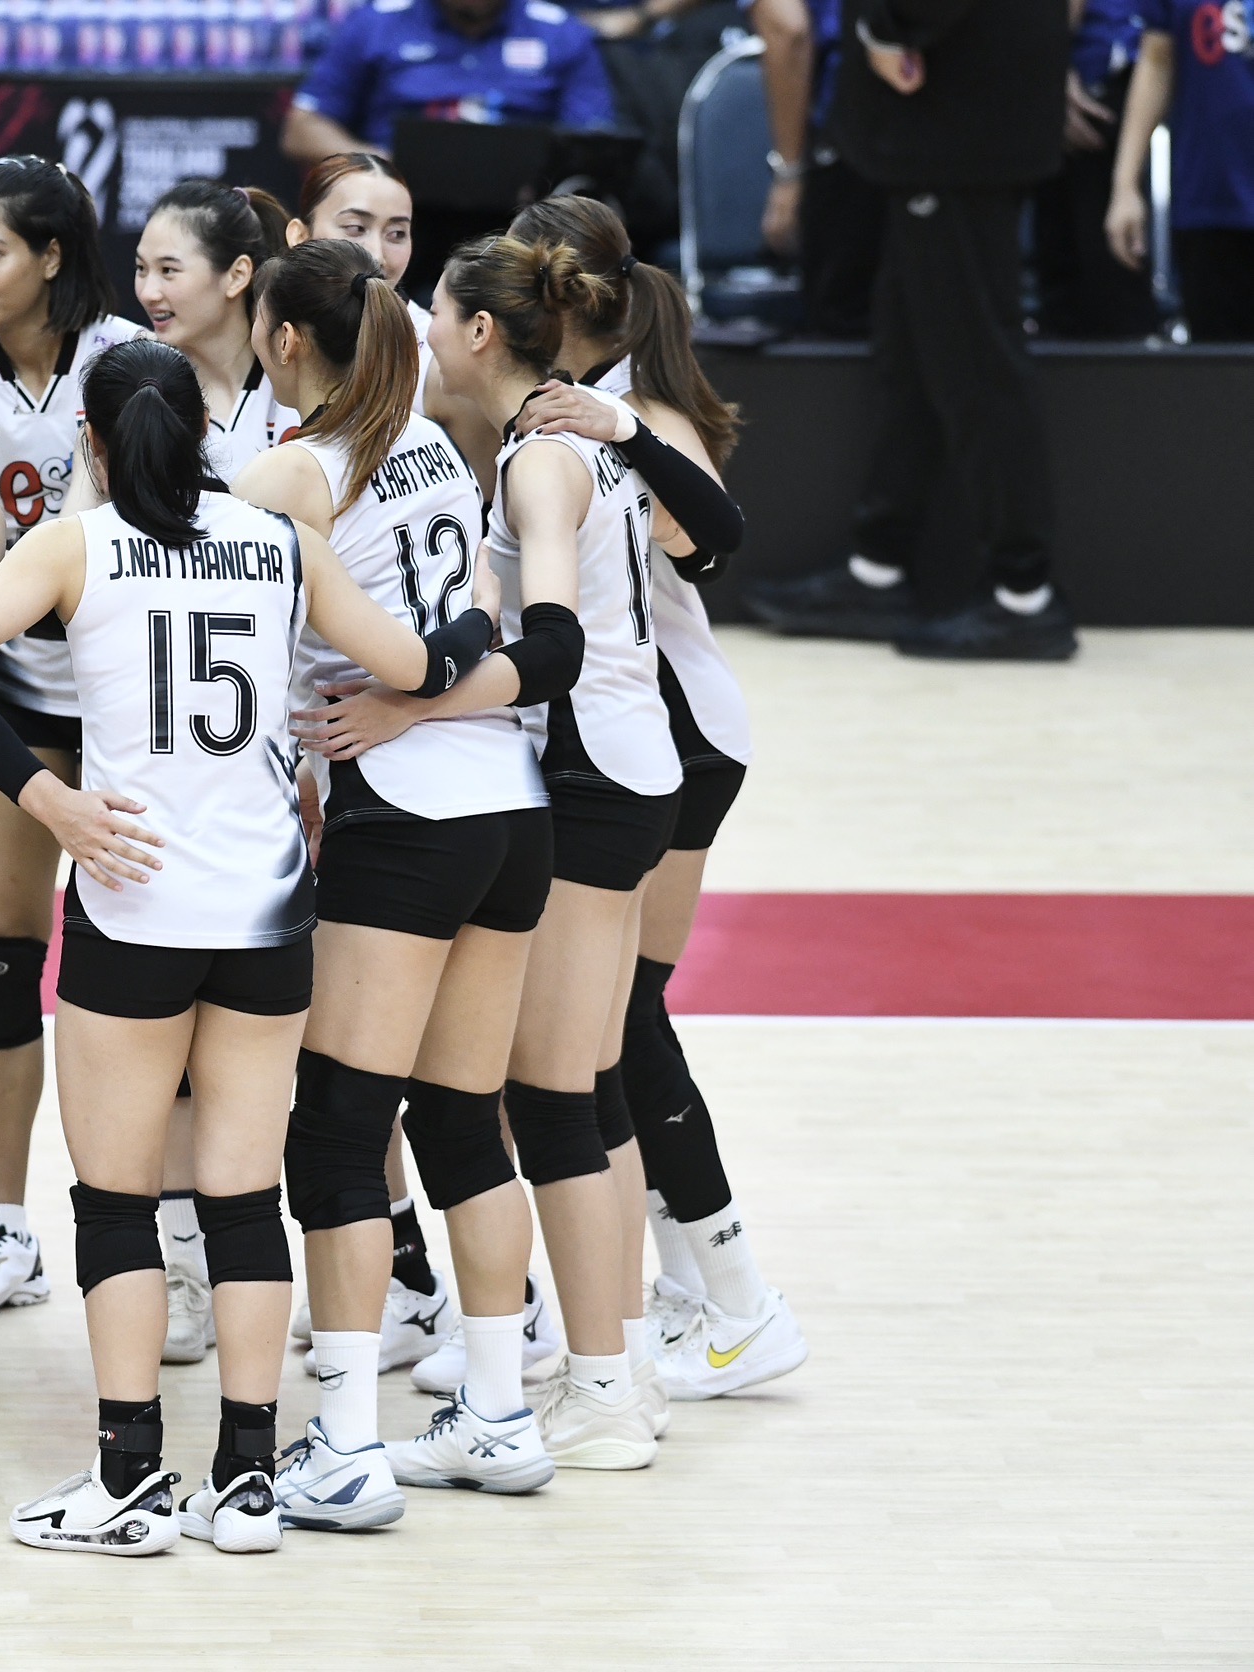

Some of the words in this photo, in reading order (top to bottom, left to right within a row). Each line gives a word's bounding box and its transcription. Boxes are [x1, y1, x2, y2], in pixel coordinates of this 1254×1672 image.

[0, 452, 73, 526] es
[110, 538, 284, 584] J.NATTHANICHA
[393, 513, 471, 638] 12
[148, 610, 257, 757] 15
